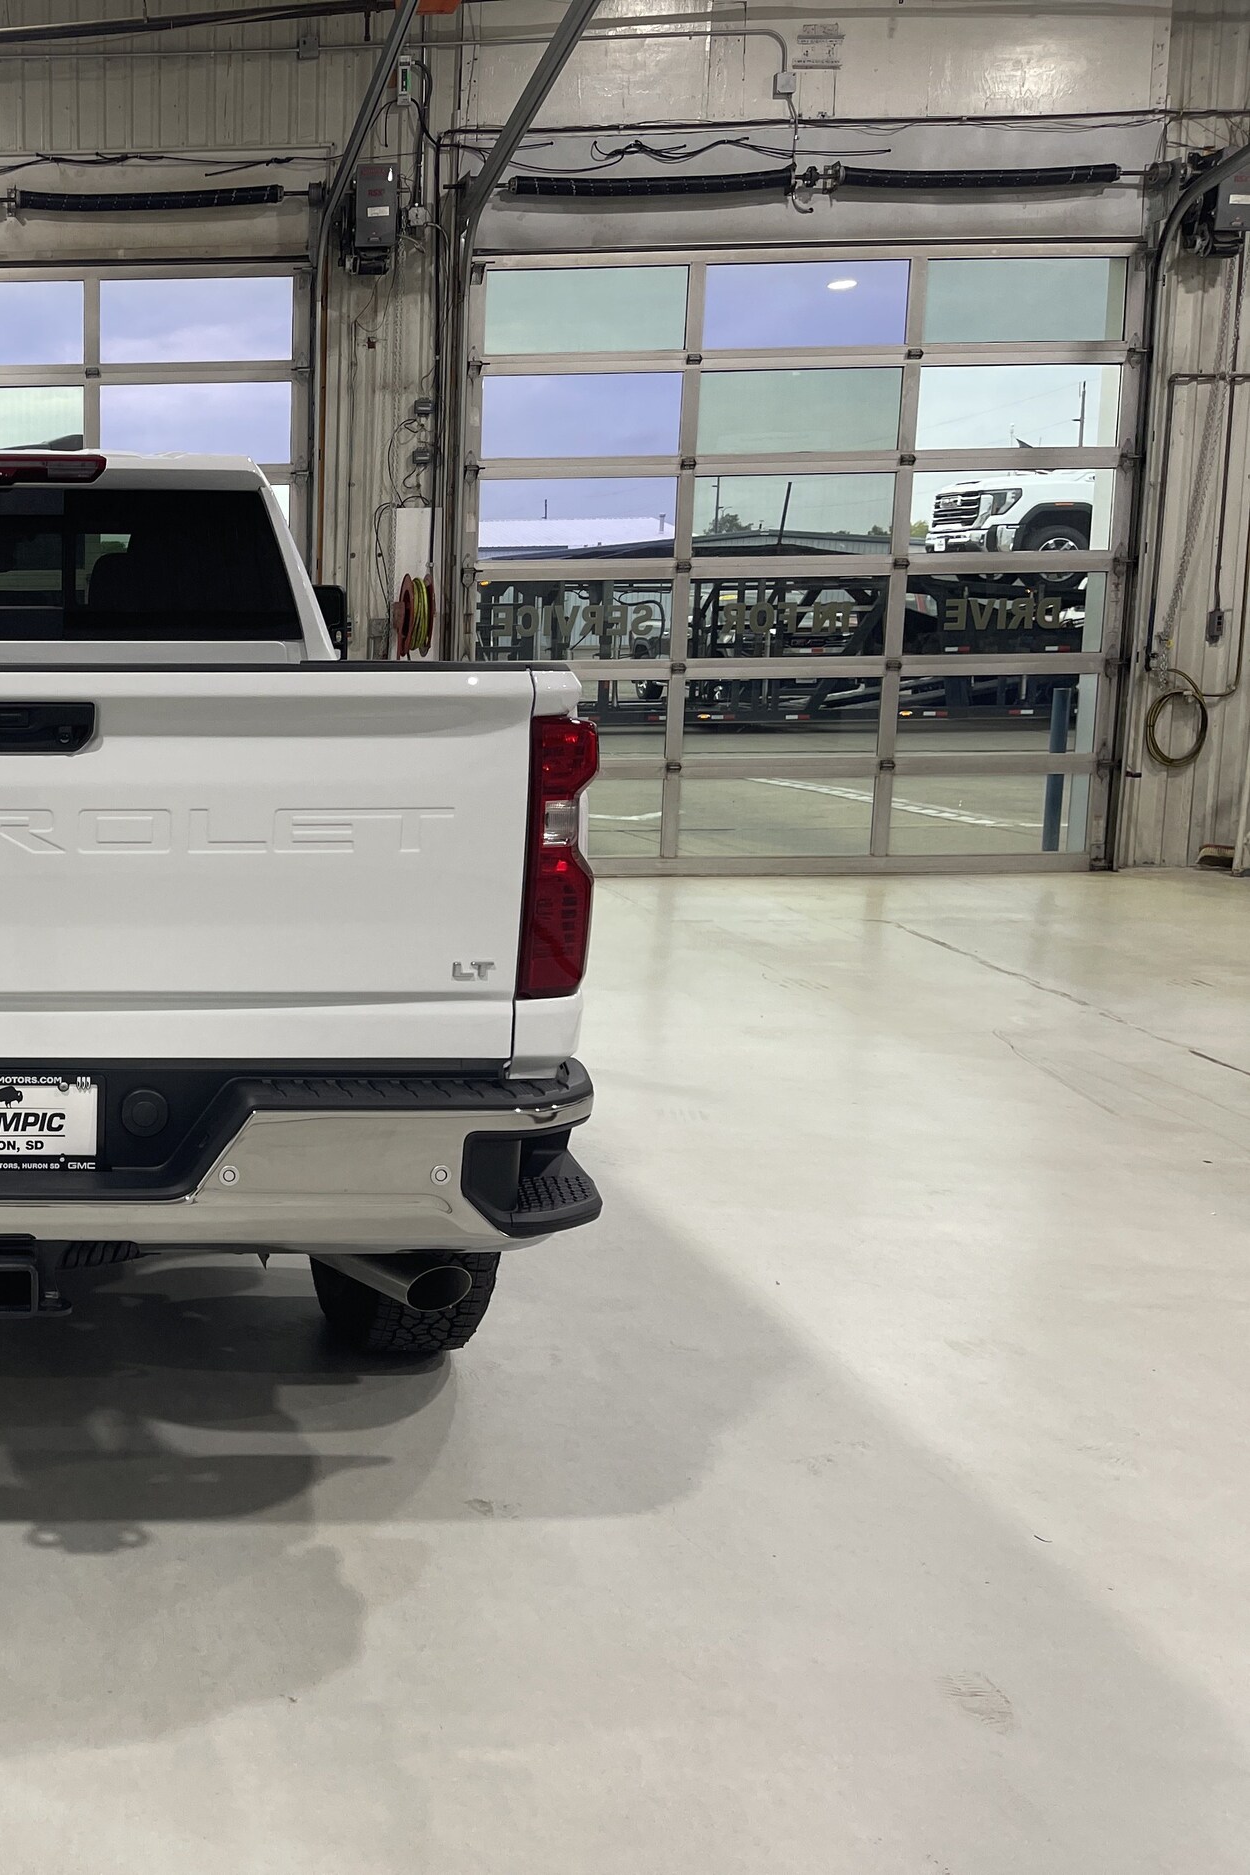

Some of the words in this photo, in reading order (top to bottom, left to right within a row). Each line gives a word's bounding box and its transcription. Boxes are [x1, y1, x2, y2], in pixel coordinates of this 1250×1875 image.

[451, 961, 496, 981] LT
[25, 1140, 44, 1151] SD
[67, 1161, 96, 1169] GMC
